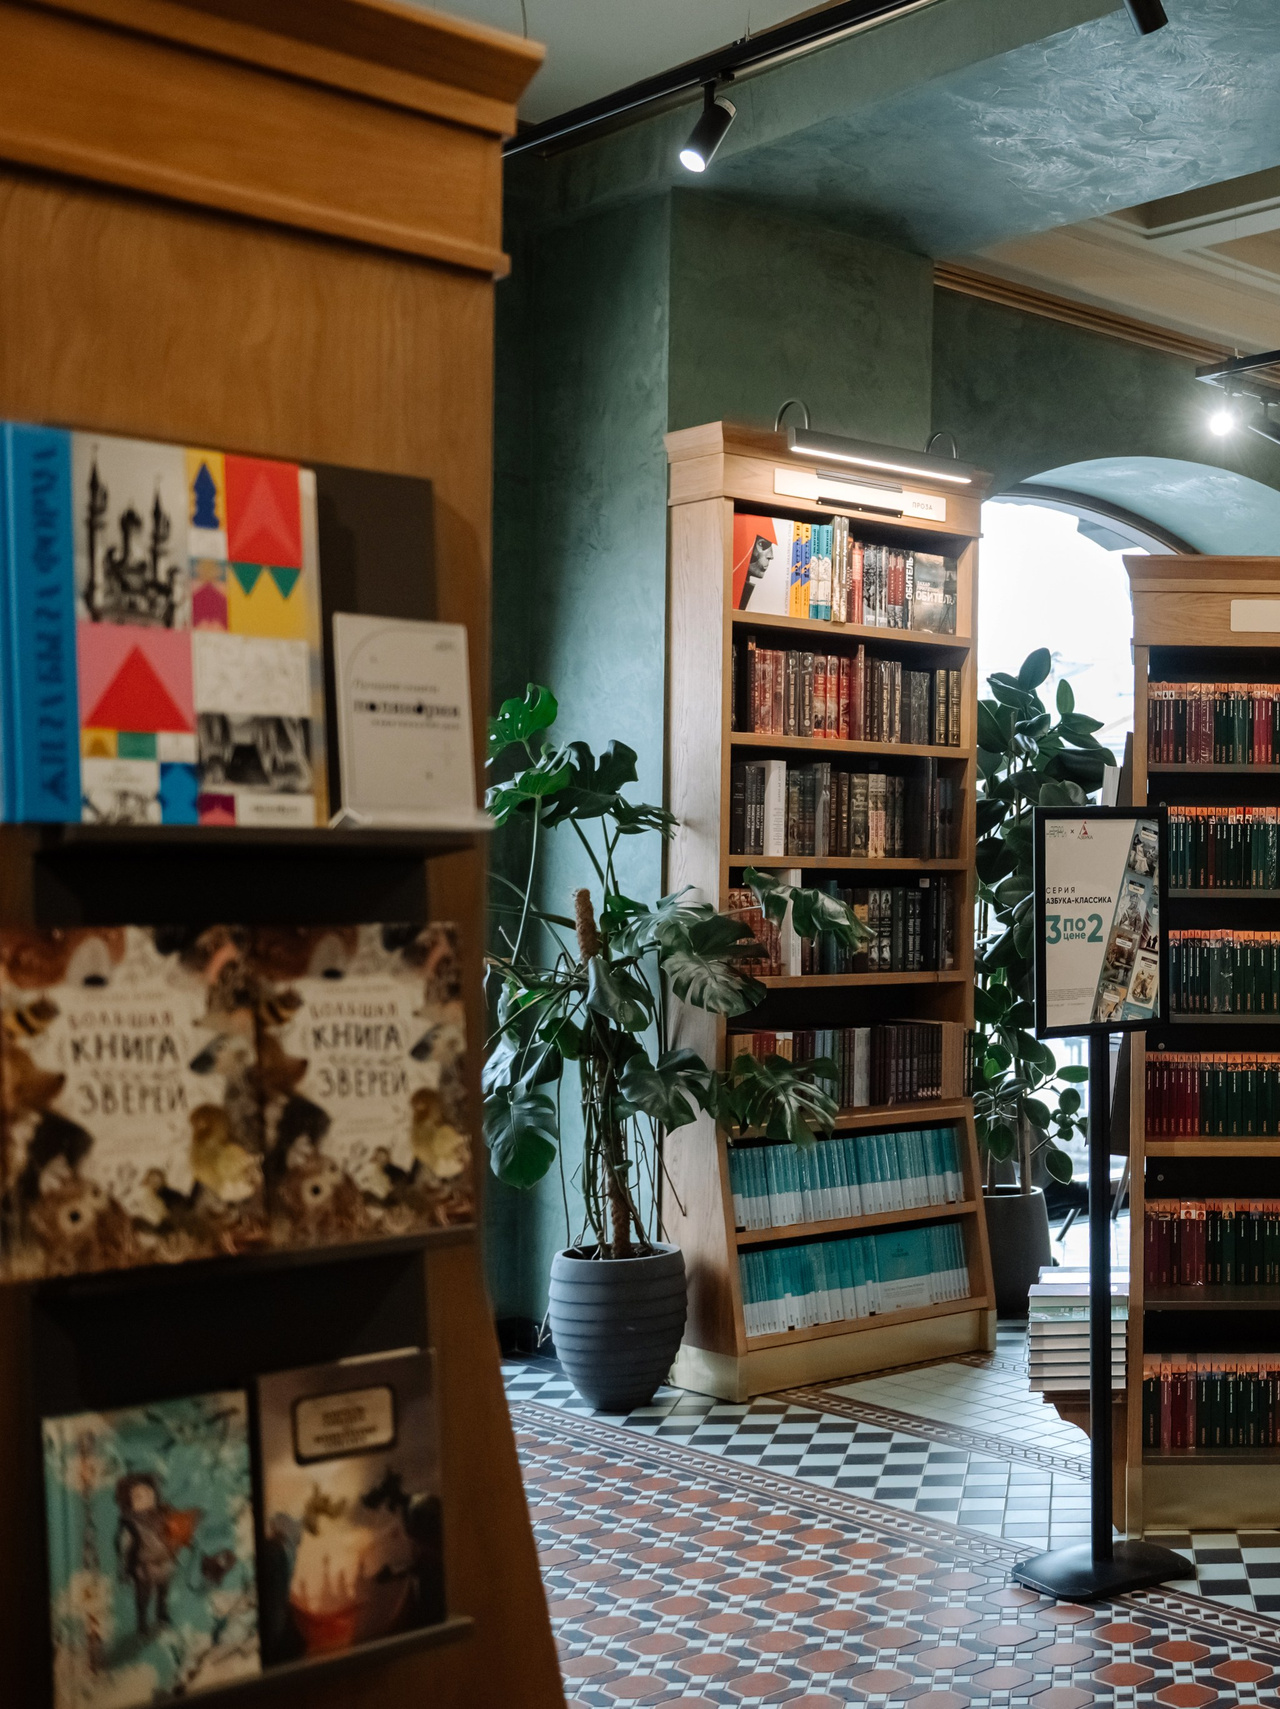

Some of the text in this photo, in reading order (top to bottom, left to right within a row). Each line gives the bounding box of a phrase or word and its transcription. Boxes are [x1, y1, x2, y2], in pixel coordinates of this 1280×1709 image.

[911, 501, 933, 511] ПРОЗА
[906, 556, 914, 600] ОБИТЕЛЬ
[915, 591, 955, 605] ОБИТЕЛЬ
[1045, 886, 1076, 894] СЕРИЯ
[1046, 896, 1112, 905] АЗБУКА-КЛАССИКА
[1046, 914, 1062, 945] 3
[1063, 932, 1087, 941] цене
[1087, 912, 1104, 943] 2
[312, 1022, 404, 1052] КНИГА
[70, 1032, 181, 1065] КНИГА
